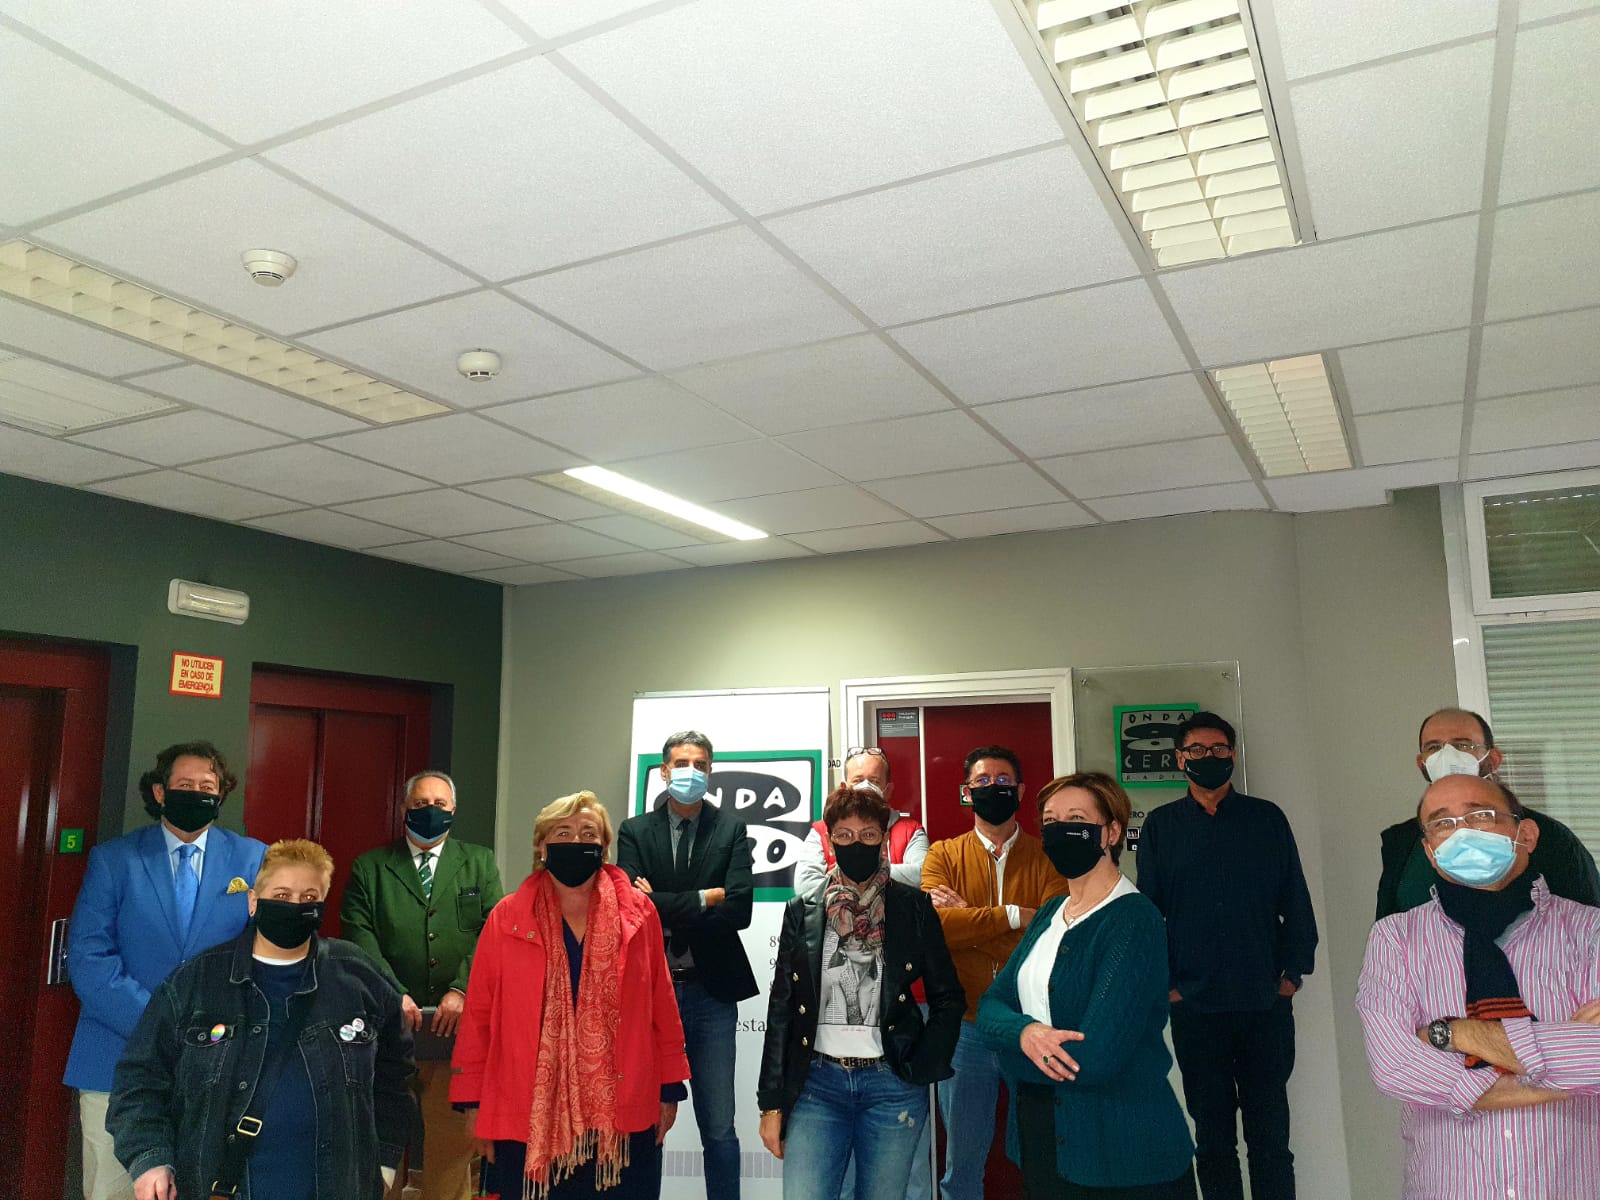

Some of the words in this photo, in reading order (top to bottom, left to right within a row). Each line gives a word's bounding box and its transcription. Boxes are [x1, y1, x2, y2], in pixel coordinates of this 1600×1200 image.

[182, 658, 189, 667] NO
[190, 659, 214, 670] UTILICEN
[181, 669, 189, 677] EN
[190, 670, 205, 680] CASO
[206, 672, 214, 681] DE
[178, 680, 213, 690] EMERGENCIA
[1129, 713, 1186, 723] ONDA
[1124, 753, 1171, 769] CER
[703, 786, 787, 810] NDA
[67, 835, 76, 849] 5
